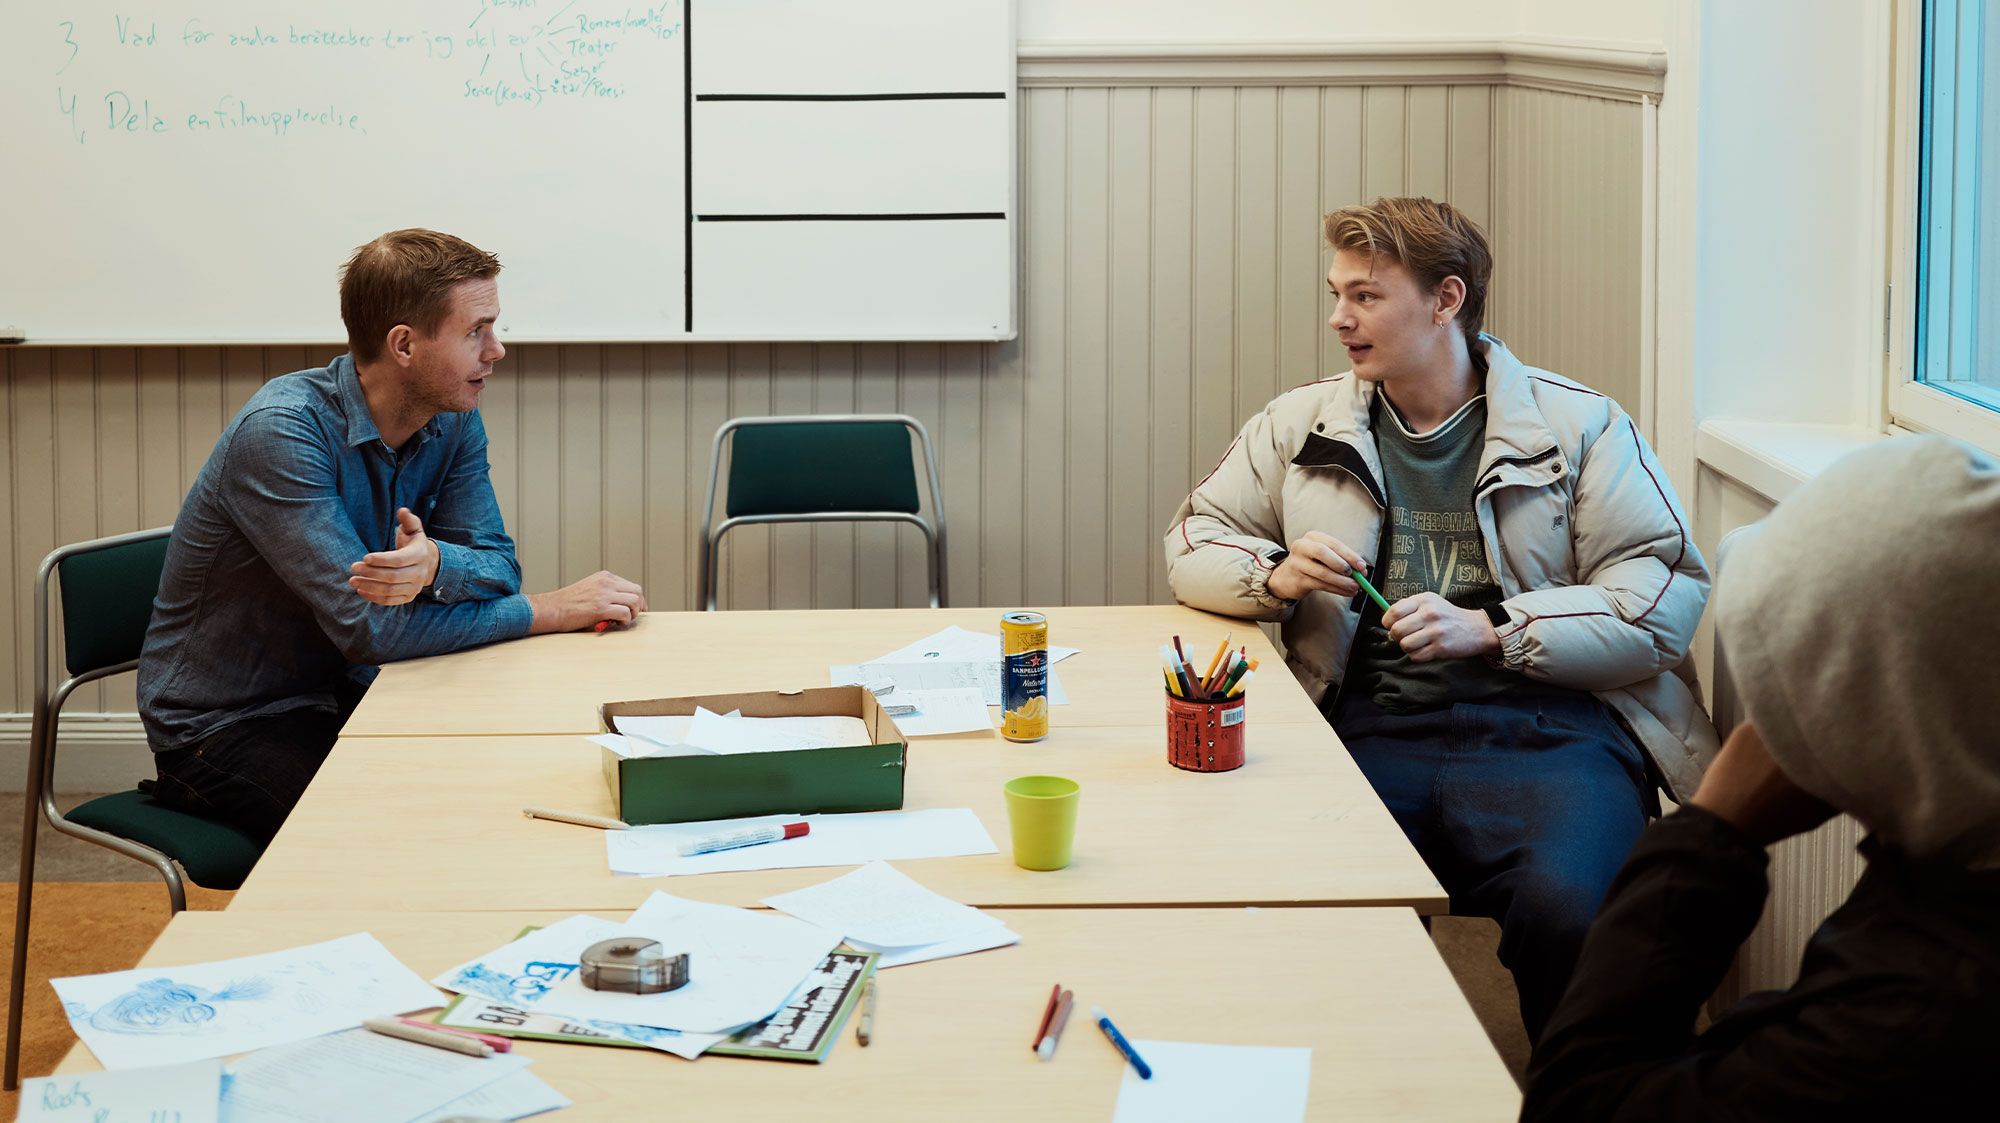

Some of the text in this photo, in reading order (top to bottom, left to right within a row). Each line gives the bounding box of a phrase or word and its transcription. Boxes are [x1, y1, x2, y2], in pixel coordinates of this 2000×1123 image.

[115, 13, 157, 47] Vad
[103, 91, 168, 133] Dela
[1411, 511, 1461, 531] FREEDOM
